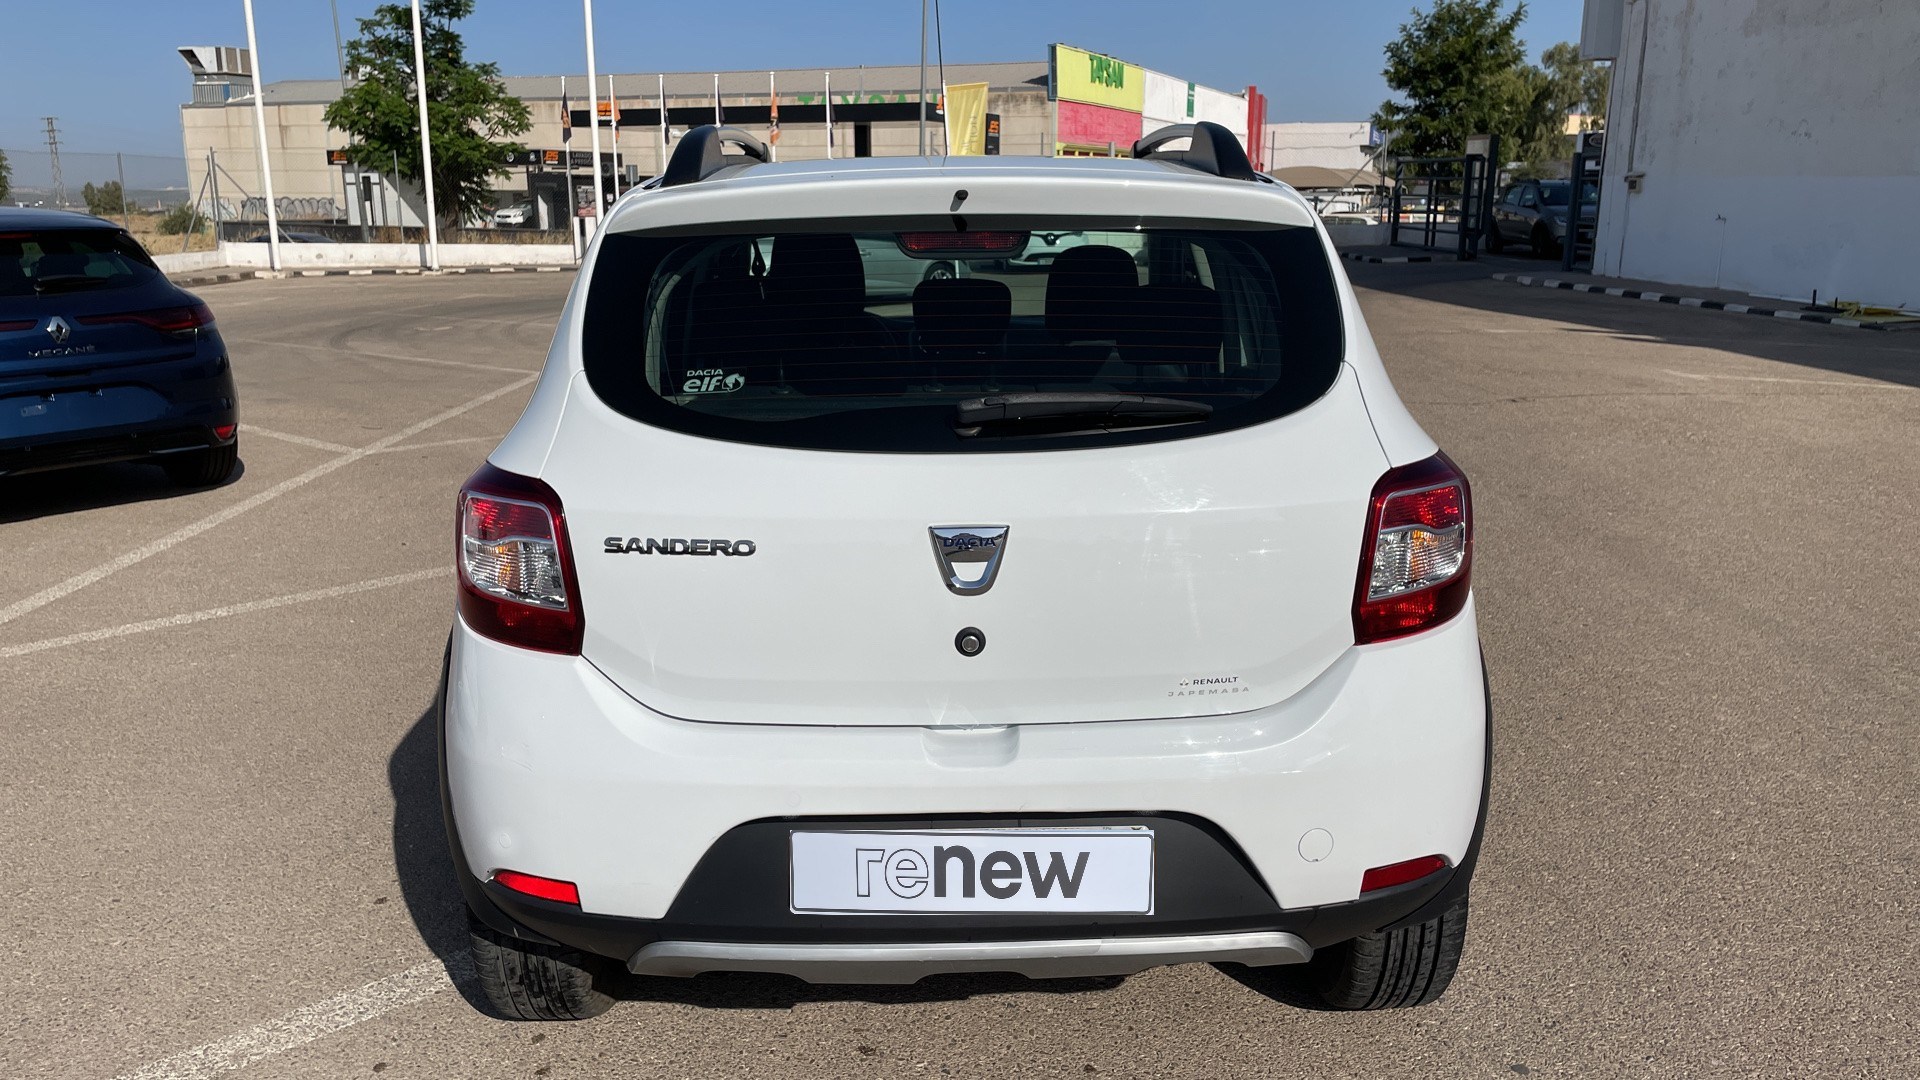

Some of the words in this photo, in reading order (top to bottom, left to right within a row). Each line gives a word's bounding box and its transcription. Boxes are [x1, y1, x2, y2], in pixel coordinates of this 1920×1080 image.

[686, 368, 724, 377] DACIA
[682, 376, 723, 392] elf
[604, 536, 757, 557] SANDERO
[943, 537, 997, 548] DACIA
[1192, 676, 1239, 686] RENAULT
[855, 845, 1090, 899] renew
